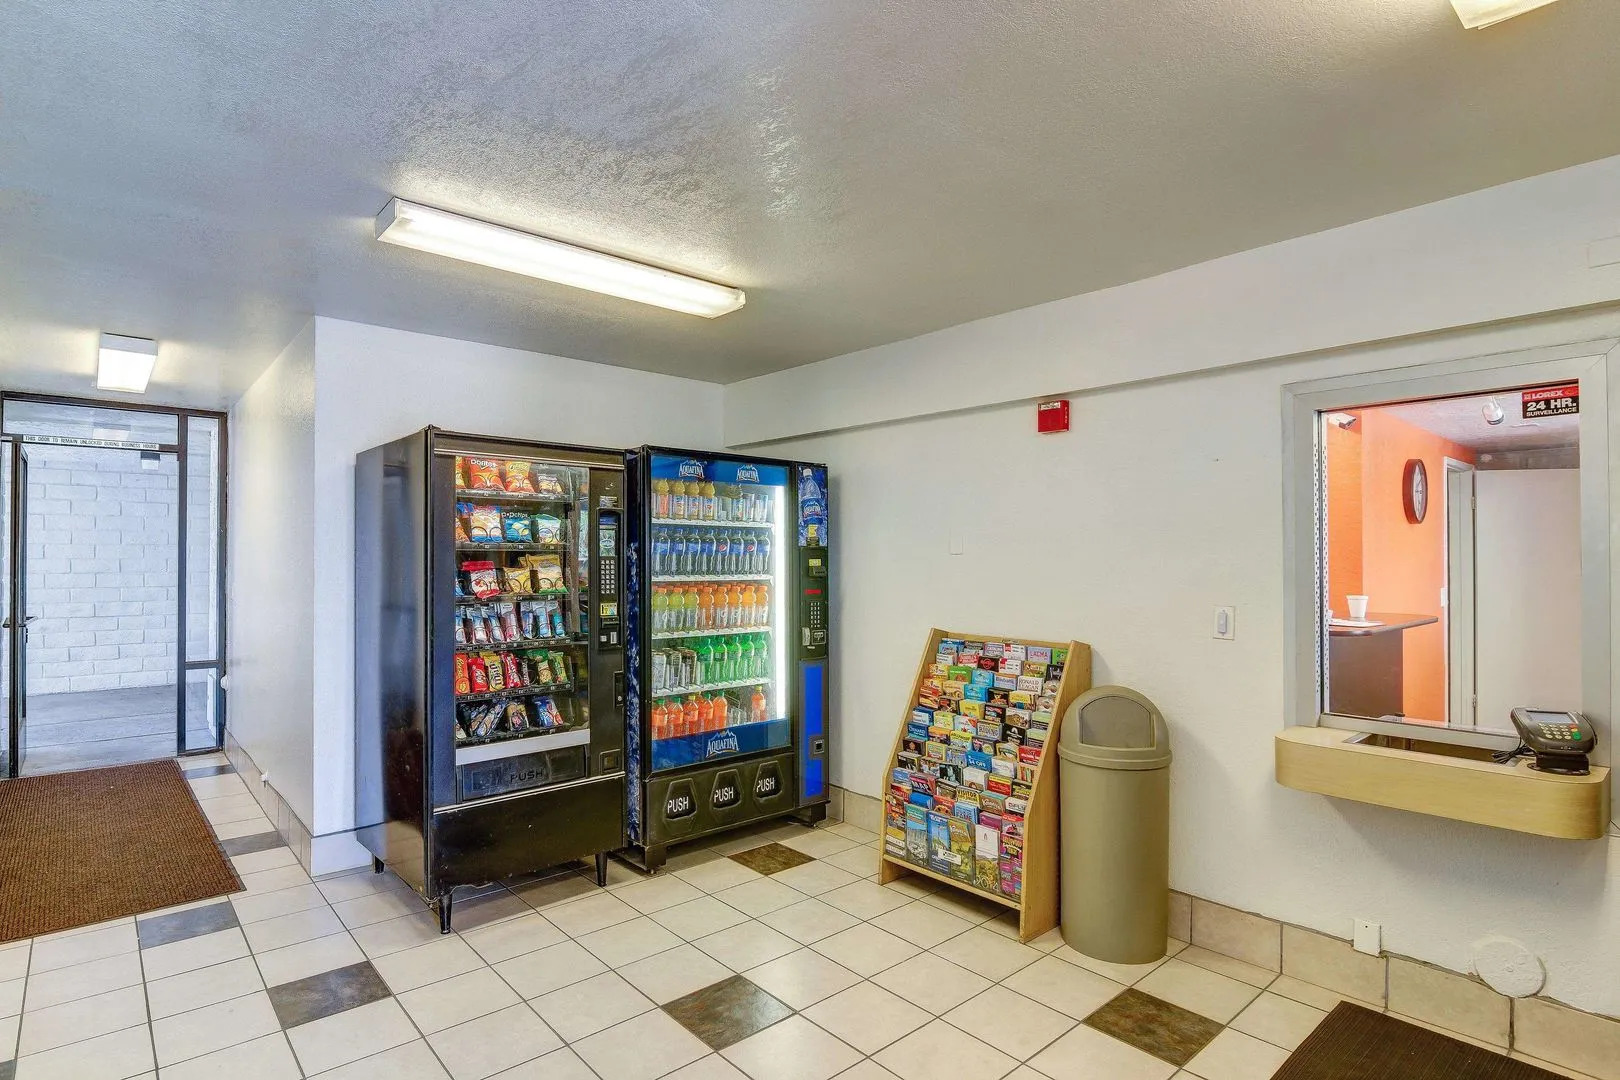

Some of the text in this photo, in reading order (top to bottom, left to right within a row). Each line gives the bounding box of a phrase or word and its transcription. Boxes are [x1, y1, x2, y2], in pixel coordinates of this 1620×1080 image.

[1532, 390, 1563, 399] LOREX
[1527, 397, 1577, 411] 24 HR.
[1526, 407, 1577, 417] SURVEILLANCE
[471, 459, 497, 468] Doritos
[679, 463, 704, 478] AQUAFINA
[736, 468, 759, 482] AQUAFINA
[706, 736, 739, 757] AQUAFINA
[510, 768, 543, 783] PUSH
[756, 777, 775, 792] PUSH
[713, 786, 734, 803] PUSH
[667, 796, 689, 814] PUSH
